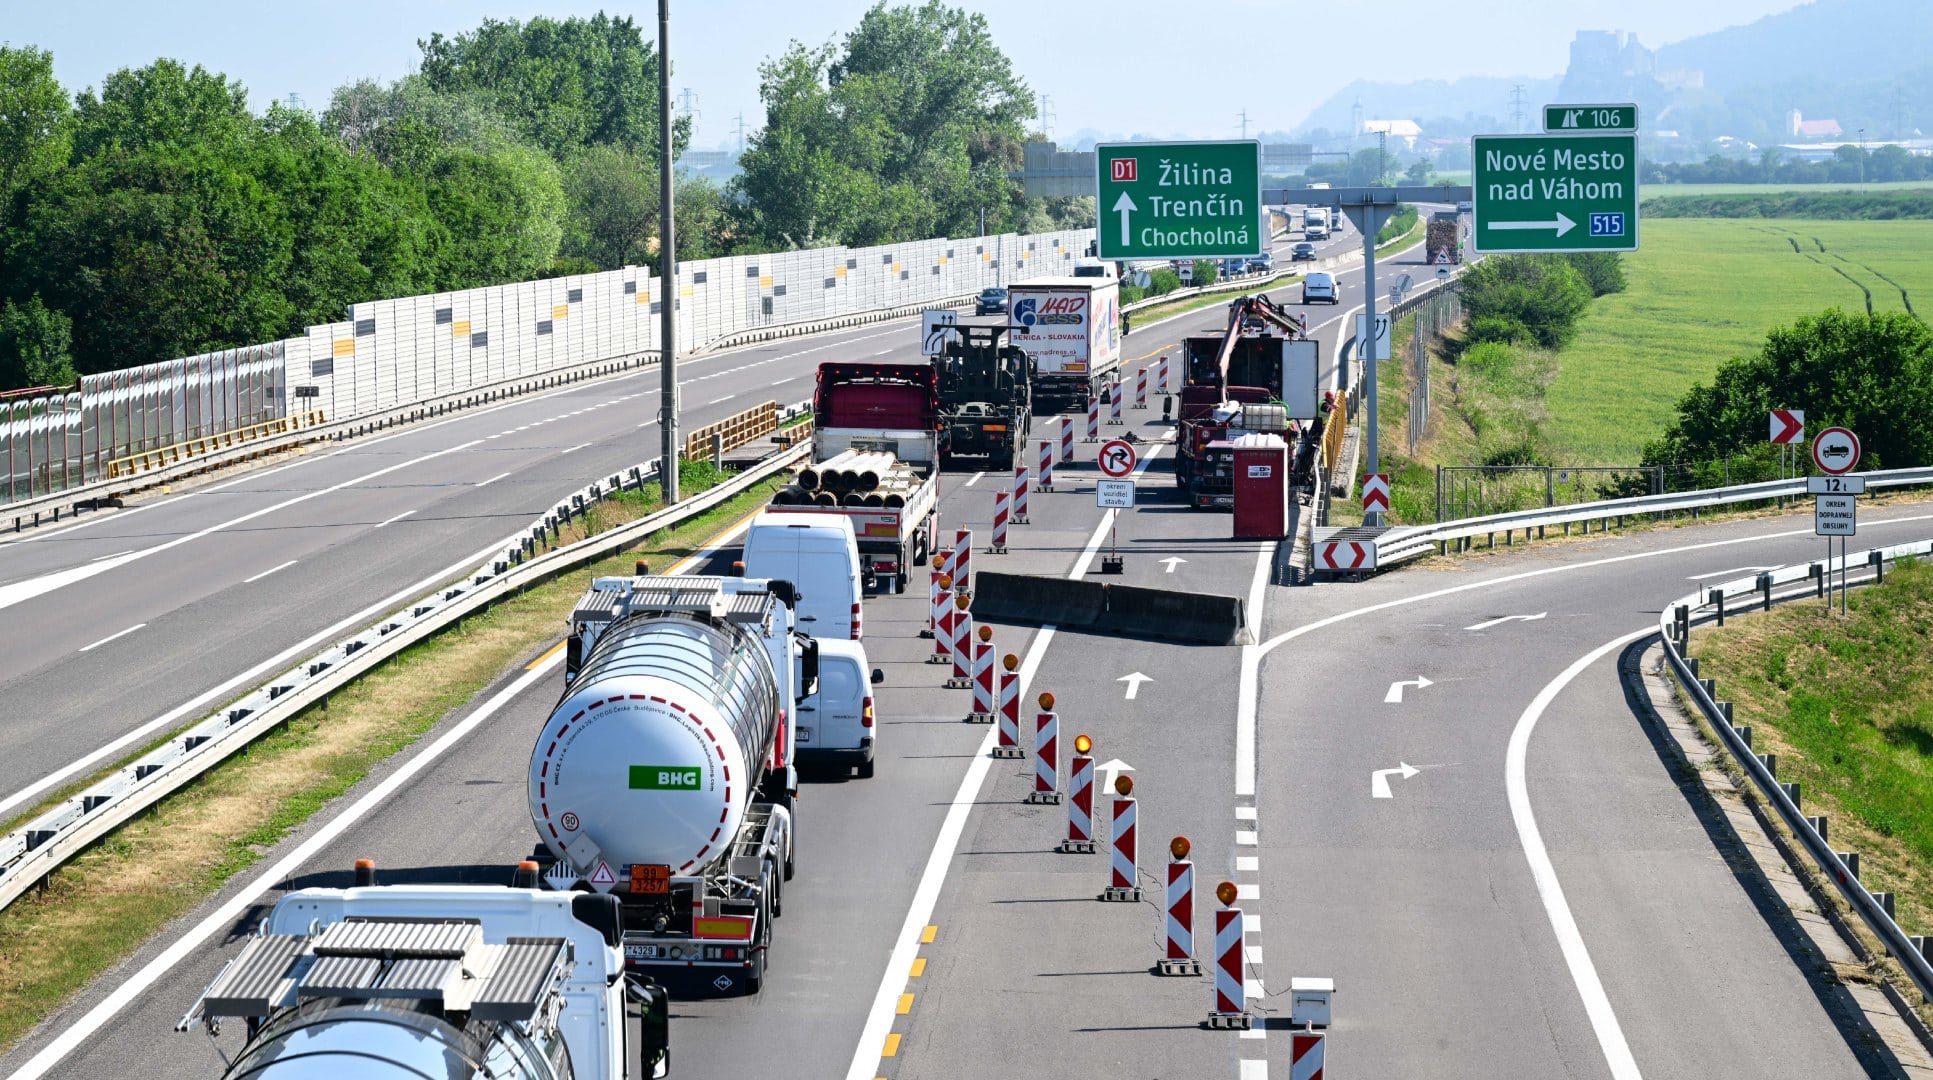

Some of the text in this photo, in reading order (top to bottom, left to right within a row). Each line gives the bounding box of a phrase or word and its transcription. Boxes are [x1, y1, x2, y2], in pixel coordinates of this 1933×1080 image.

[1590, 109, 1621, 127] 106
[1486, 148, 1625, 172] Nové Mesto
[1114, 161, 1134, 179] D1
[1158, 158, 1232, 186] Žilina
[1489, 177, 1623, 201] nad Váhom
[1148, 193, 1244, 218] Trenčín
[1593, 215, 1620, 233] 515
[1141, 225, 1249, 247] Chocholná
[1038, 297, 1086, 314] NAD
[1825, 479, 1847, 491] 12 t
[1819, 511, 1853, 519] DOPRAVNEJ
[658, 771, 697, 785] BHG
[565, 816, 576, 826] 90
[643, 867, 657, 878] 99
[636, 880, 665, 892] 3257
[632, 946, 653, 955] 4329
